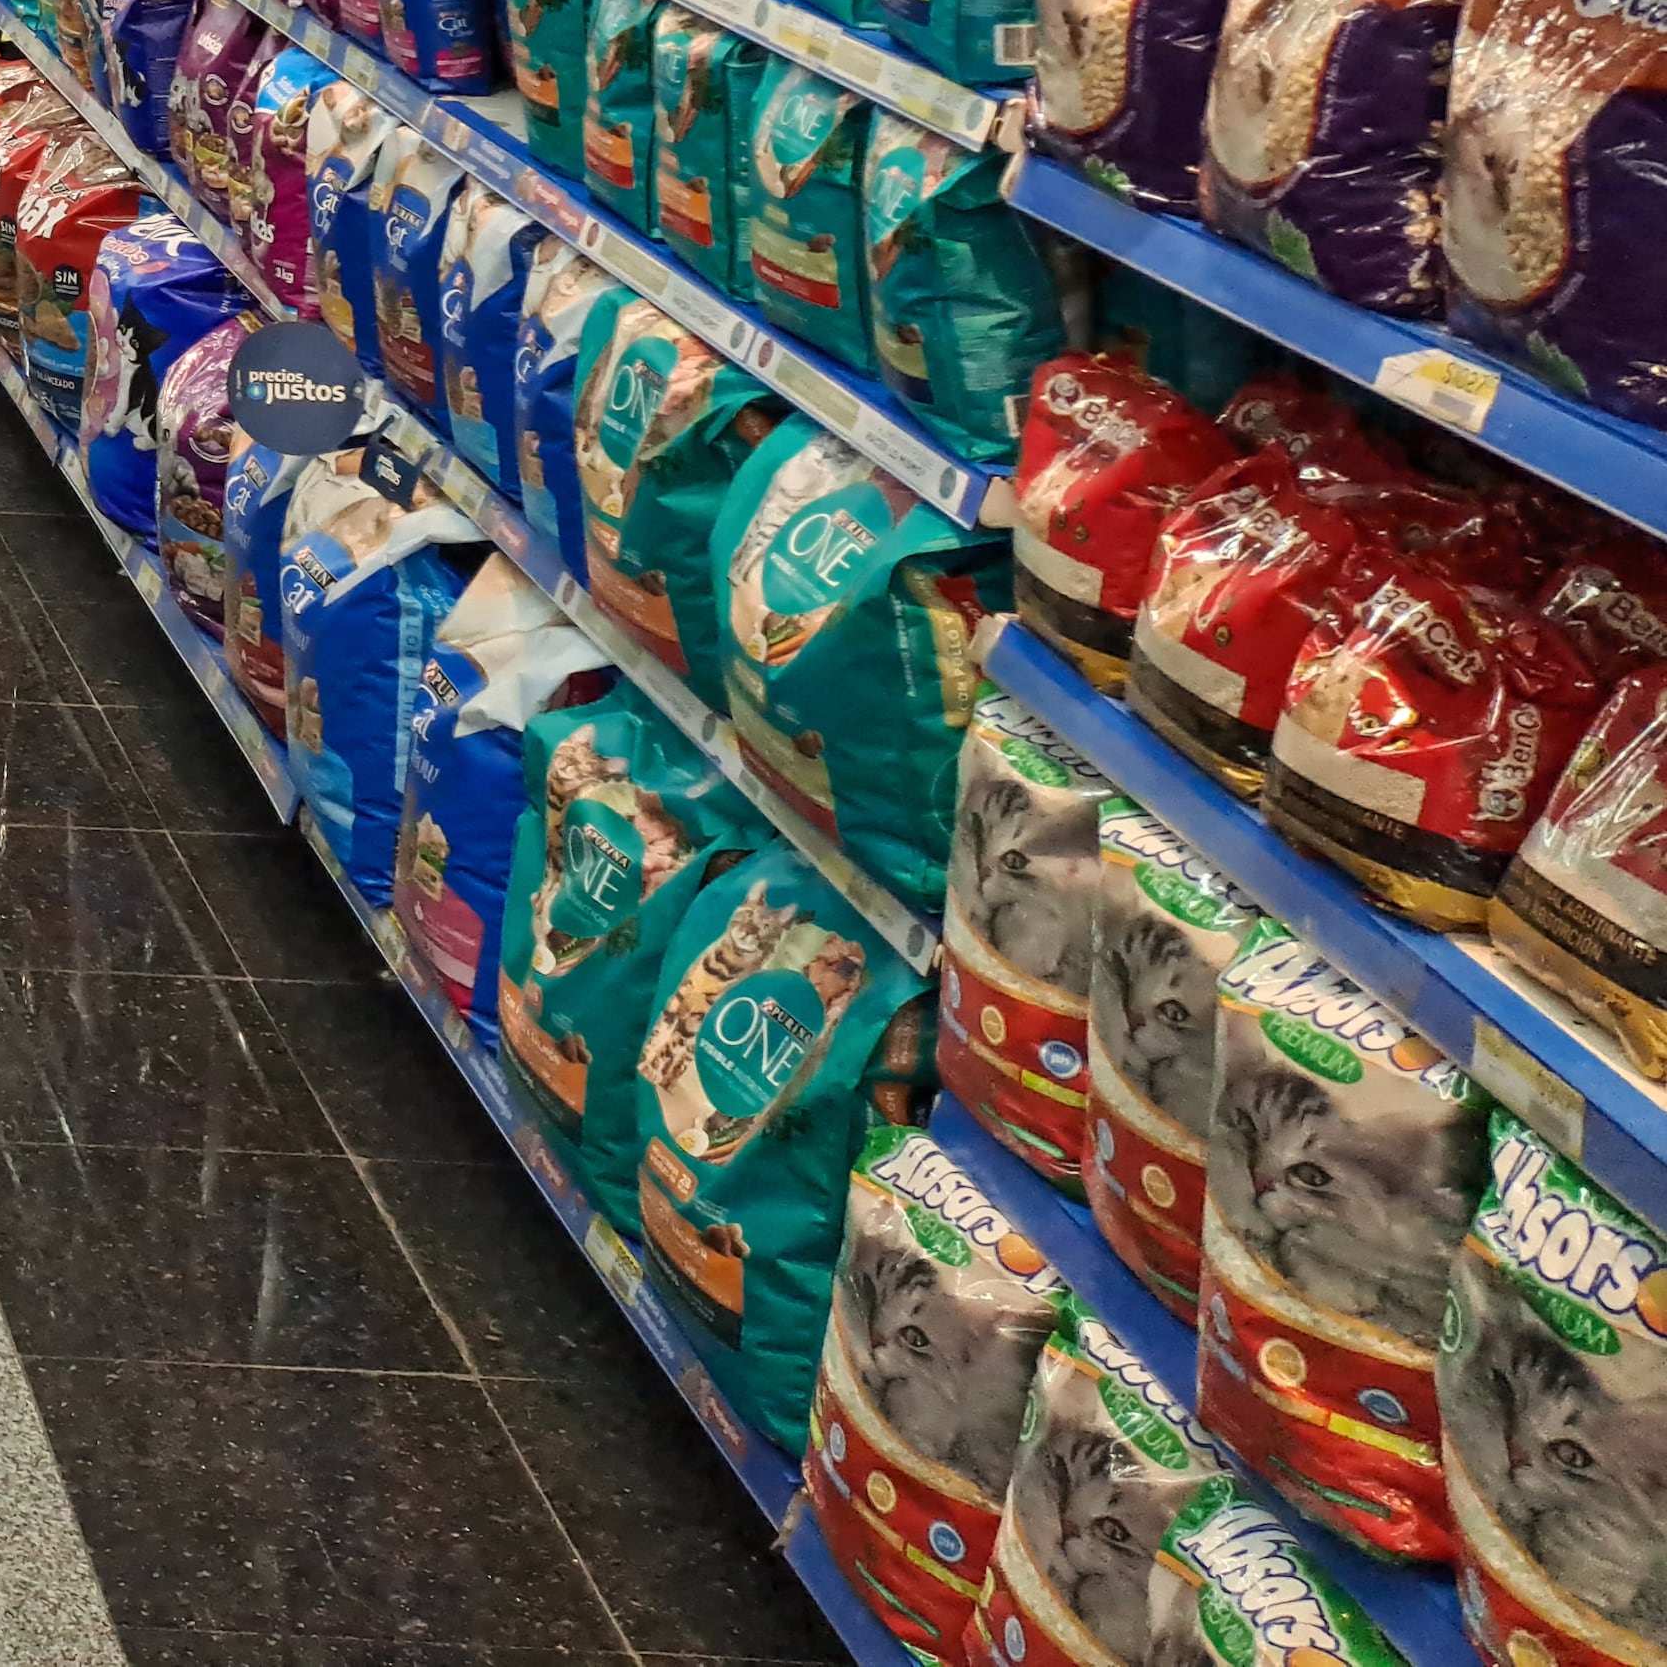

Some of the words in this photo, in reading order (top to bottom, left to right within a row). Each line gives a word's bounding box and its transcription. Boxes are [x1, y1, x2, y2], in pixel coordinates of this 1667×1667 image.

[781, 100, 821, 140] ONE
[0, 221, 15, 232] SIN
[55, 271, 77, 285] SIN
[248, 370, 303, 383] precios
[267, 379, 346, 403] justos
[788, 513, 865, 587] ONE
[714, 996, 805, 1087] ONE
[1268, 1014, 1357, 1082] PREMIUM
[1101, 1380, 1189, 1468] PREMIUM
